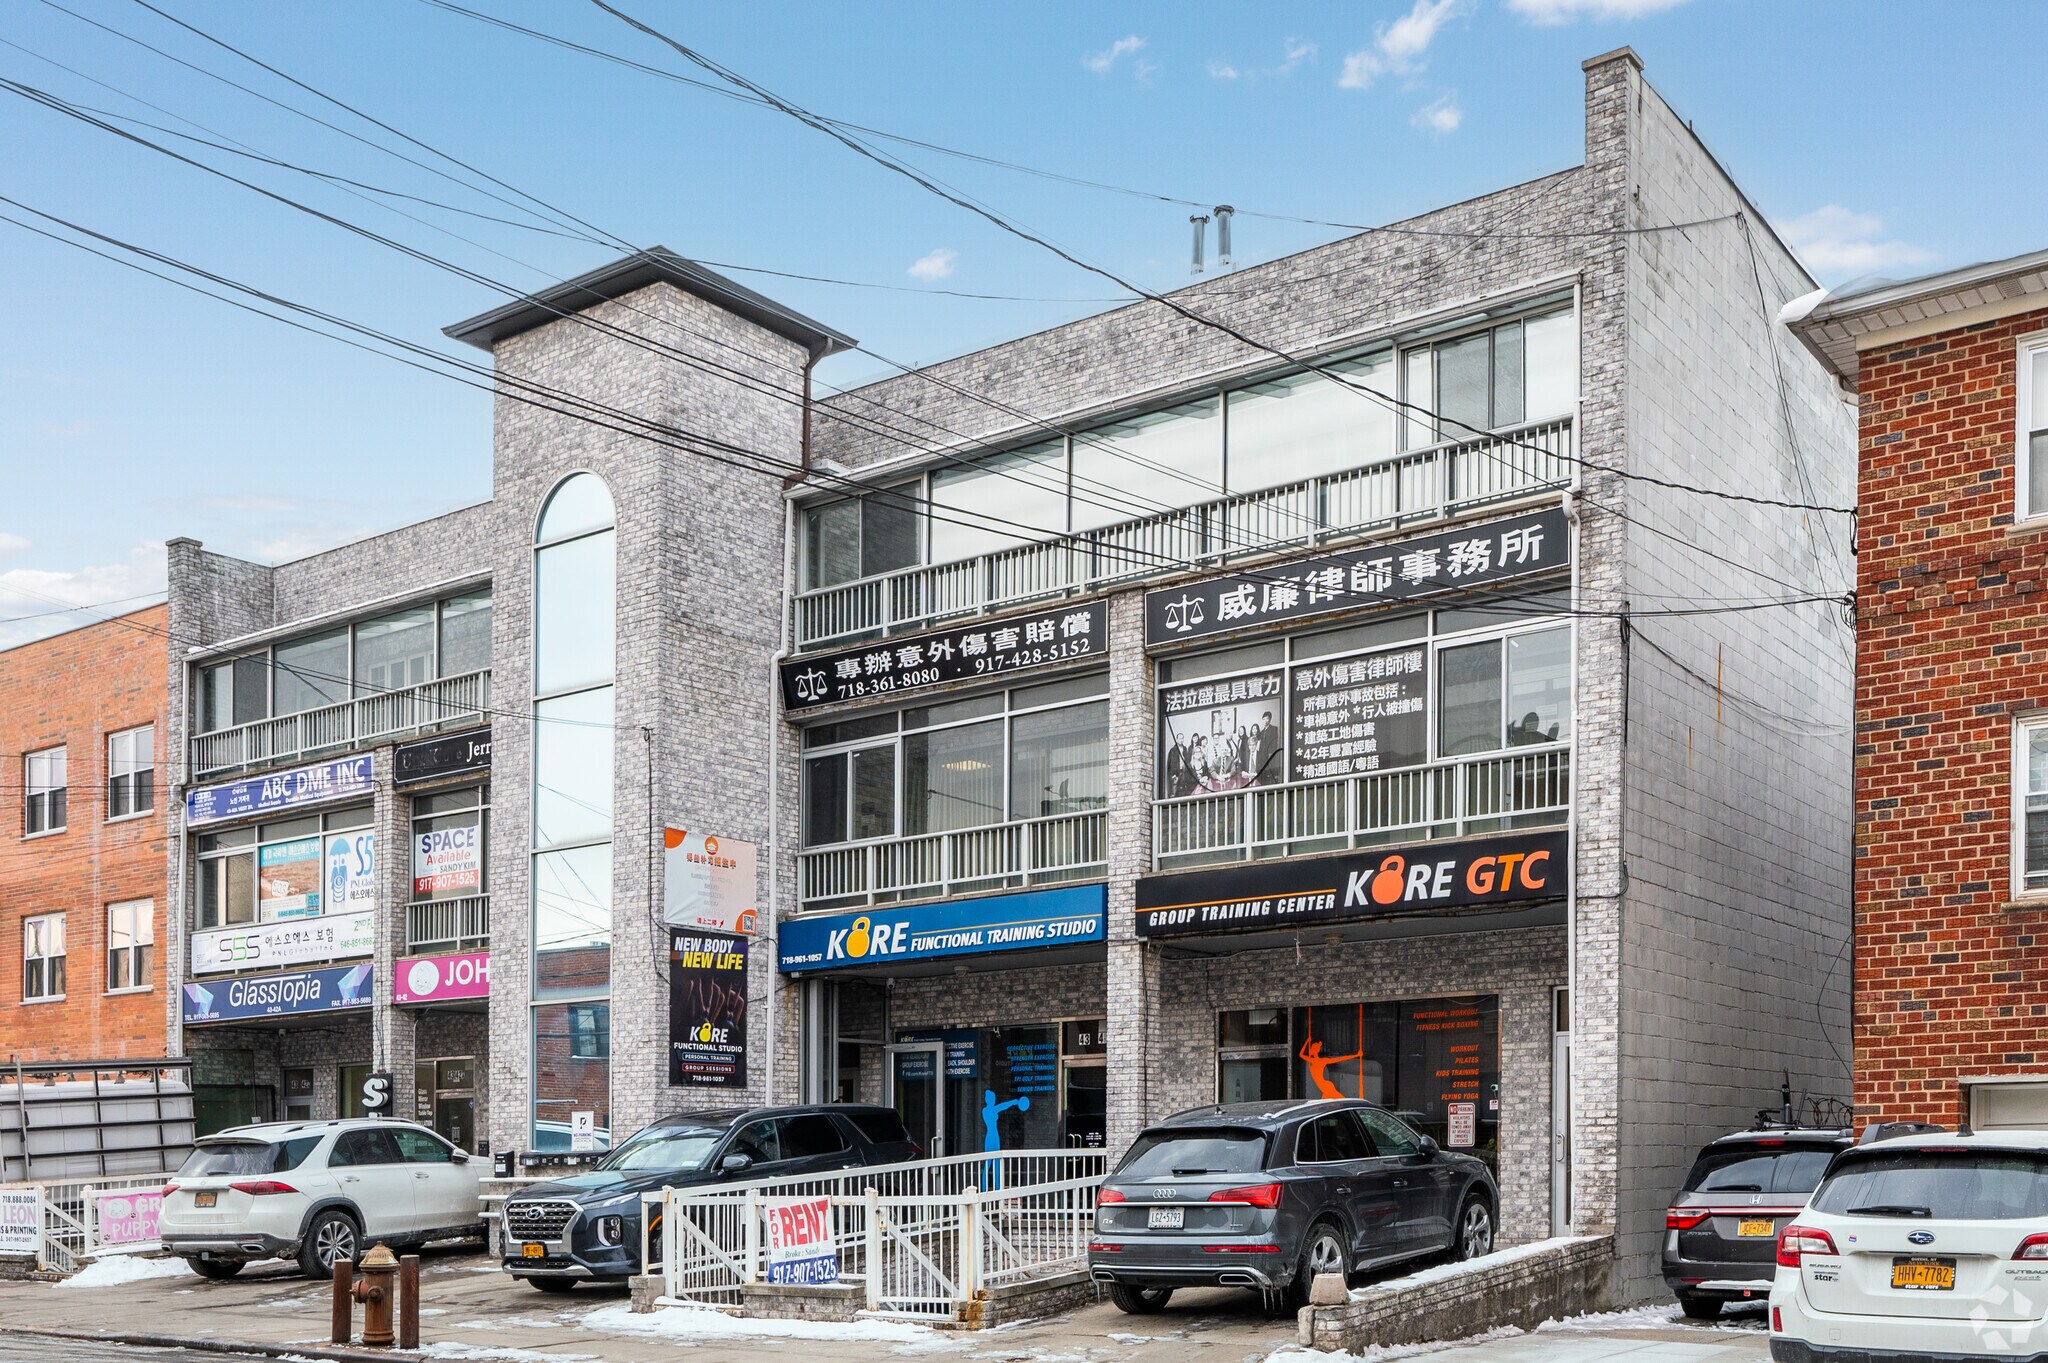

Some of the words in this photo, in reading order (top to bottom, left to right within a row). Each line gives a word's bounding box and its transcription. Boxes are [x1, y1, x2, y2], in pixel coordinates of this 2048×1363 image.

[1217, 524, 1545, 622] 威廉律師事務所
[834, 611, 1091, 680] 專辦意外傷害賠償
[838, 667, 940, 700] 718-361-8080
[975, 638, 1091, 675] 917-428-5152
[1296, 650, 1423, 692] 意外傷害律師樓
[1166, 674, 1282, 712] 法拉盛最具實力
[261, 774, 292, 801] ABC
[296, 766, 333, 794] DME
[337, 759, 366, 785] INC
[421, 828, 475, 854] SPACE
[426, 849, 471, 866] Available
[440, 862, 464, 873] SANDY
[464, 860, 477, 870] KIM
[419, 872, 475, 891] 917-907-1525
[1466, 850, 1550, 895] GTC
[1149, 908, 1196, 926] GROUP
[1201, 900, 1271, 922] TRAINING
[1277, 894, 1336, 914] CENTER
[674, 936, 701, 952] NEW
[703, 938, 735, 954] BODY
[910, 931, 983, 952] FUNCTIONAL
[987, 926, 1045, 945] TRAINING
[1046, 919, 1097, 938] STUDIO
[682, 951, 715, 969] NEW
[716, 953, 744, 971] LIFE
[782, 953, 823, 965] 718-961-1057
[445, 957, 490, 987] JOH
[1413, 1011, 1448, 1019] FUNCTIONAL
[1416, 1023, 1440, 1031] FITNESS
[673, 1041, 717, 1052] FUNCTIONAL
[718, 1044, 743, 1053] STUDIO
[1034, 1043, 1056, 1051] EXERCISE
[1079, 1033, 1091, 1046] 43
[1450, 1045, 1479, 1053] WORKOUT
[1017, 1085, 1034, 1093] SENIOR
[1441, 1093, 1462, 1101] FLYING
[2, 1205, 36, 1224] LEON
[778, 1199, 829, 1248] RENT
[10, 1226, 37, 1235] PRINTING
[773, 1259, 837, 1284] 917-907-1525
[1814, 1273, 1833, 1282] star
